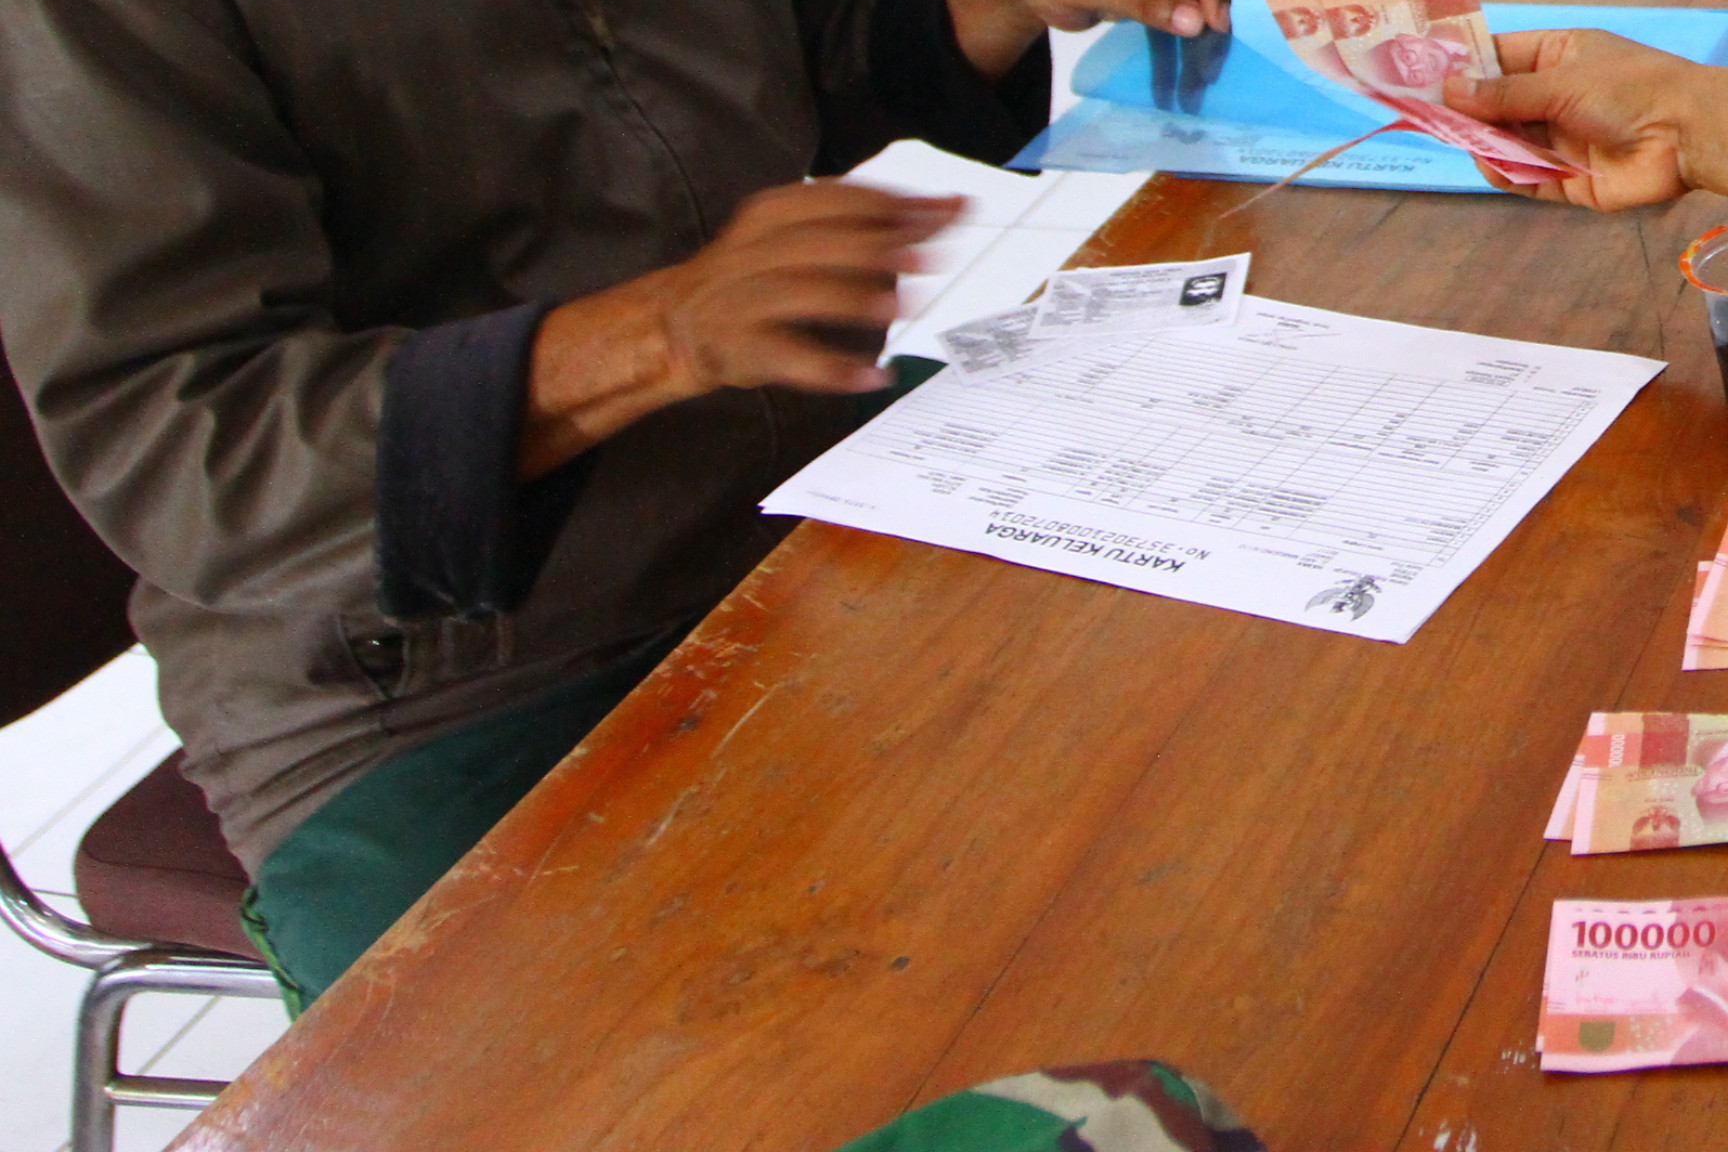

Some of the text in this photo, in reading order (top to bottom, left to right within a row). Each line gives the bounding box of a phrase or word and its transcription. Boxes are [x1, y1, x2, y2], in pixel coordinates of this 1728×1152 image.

[985, 521, 1186, 573] KARTU KELUARGA
[1571, 919, 1717, 951] 100000
[1572, 949, 1619, 959] SERATUS
